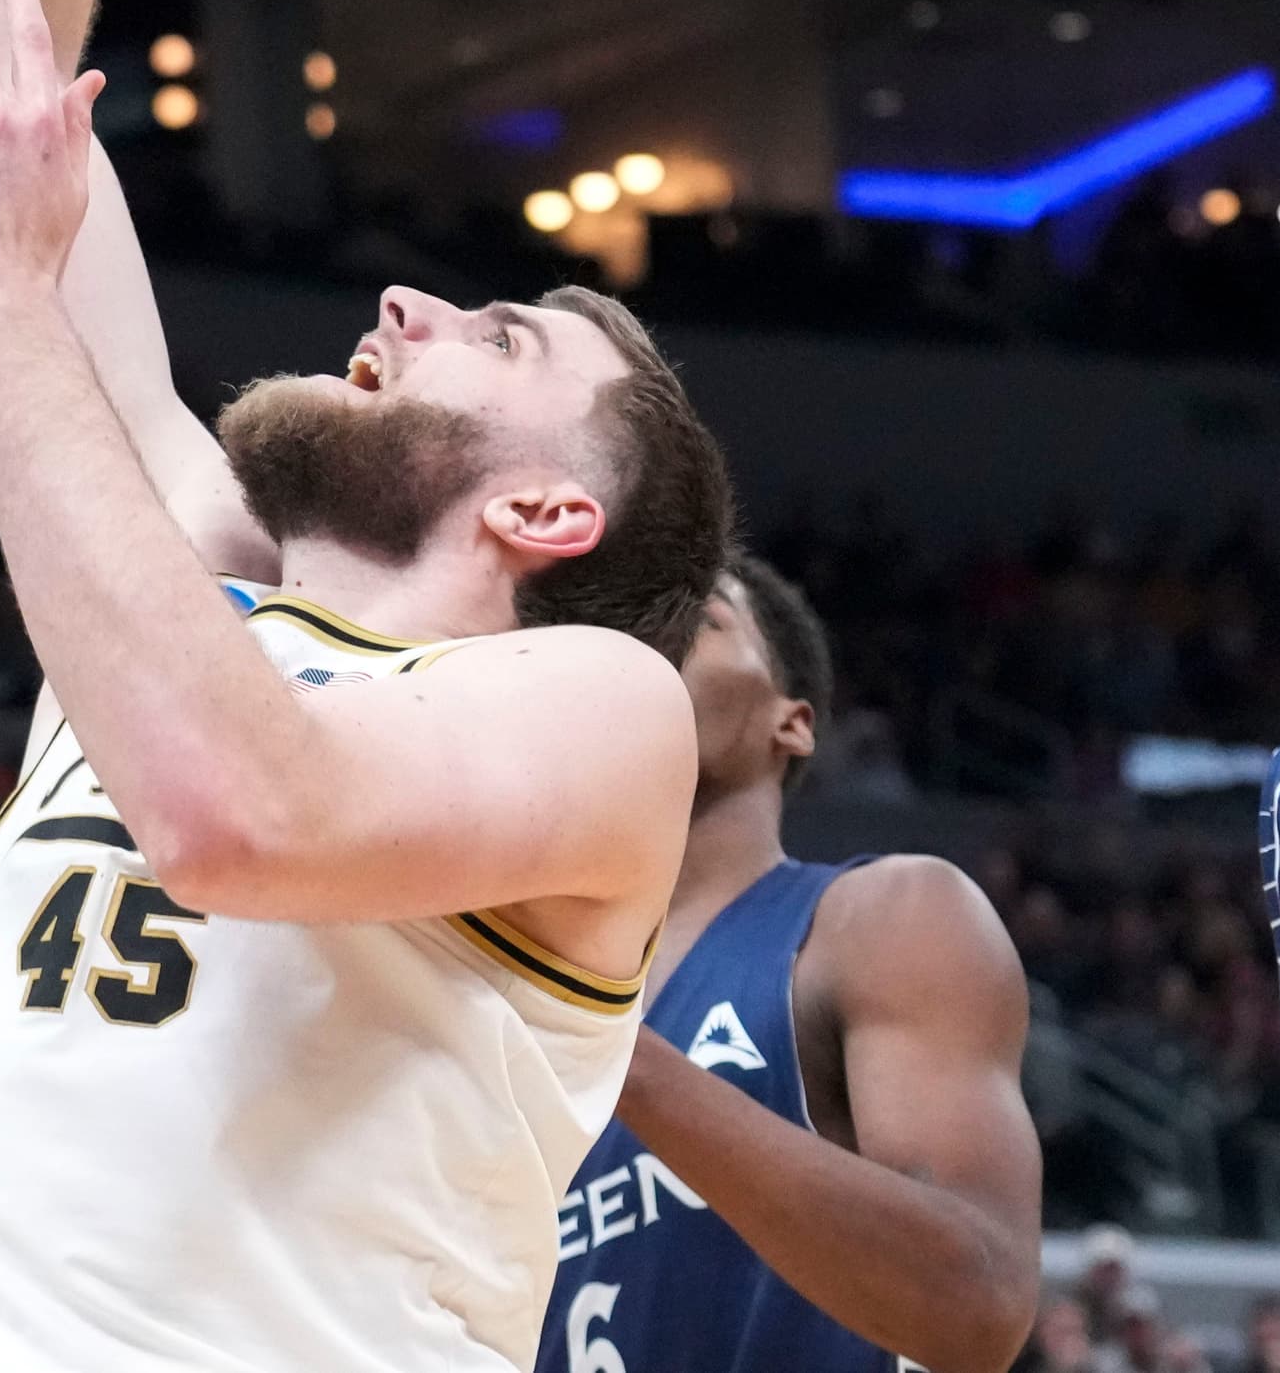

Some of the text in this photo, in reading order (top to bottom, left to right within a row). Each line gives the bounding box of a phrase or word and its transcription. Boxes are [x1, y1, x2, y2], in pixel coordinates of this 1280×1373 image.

[16, 865, 209, 1028] 45
[557, 1152, 709, 1263] EEN
[565, 1281, 627, 1373] 6
